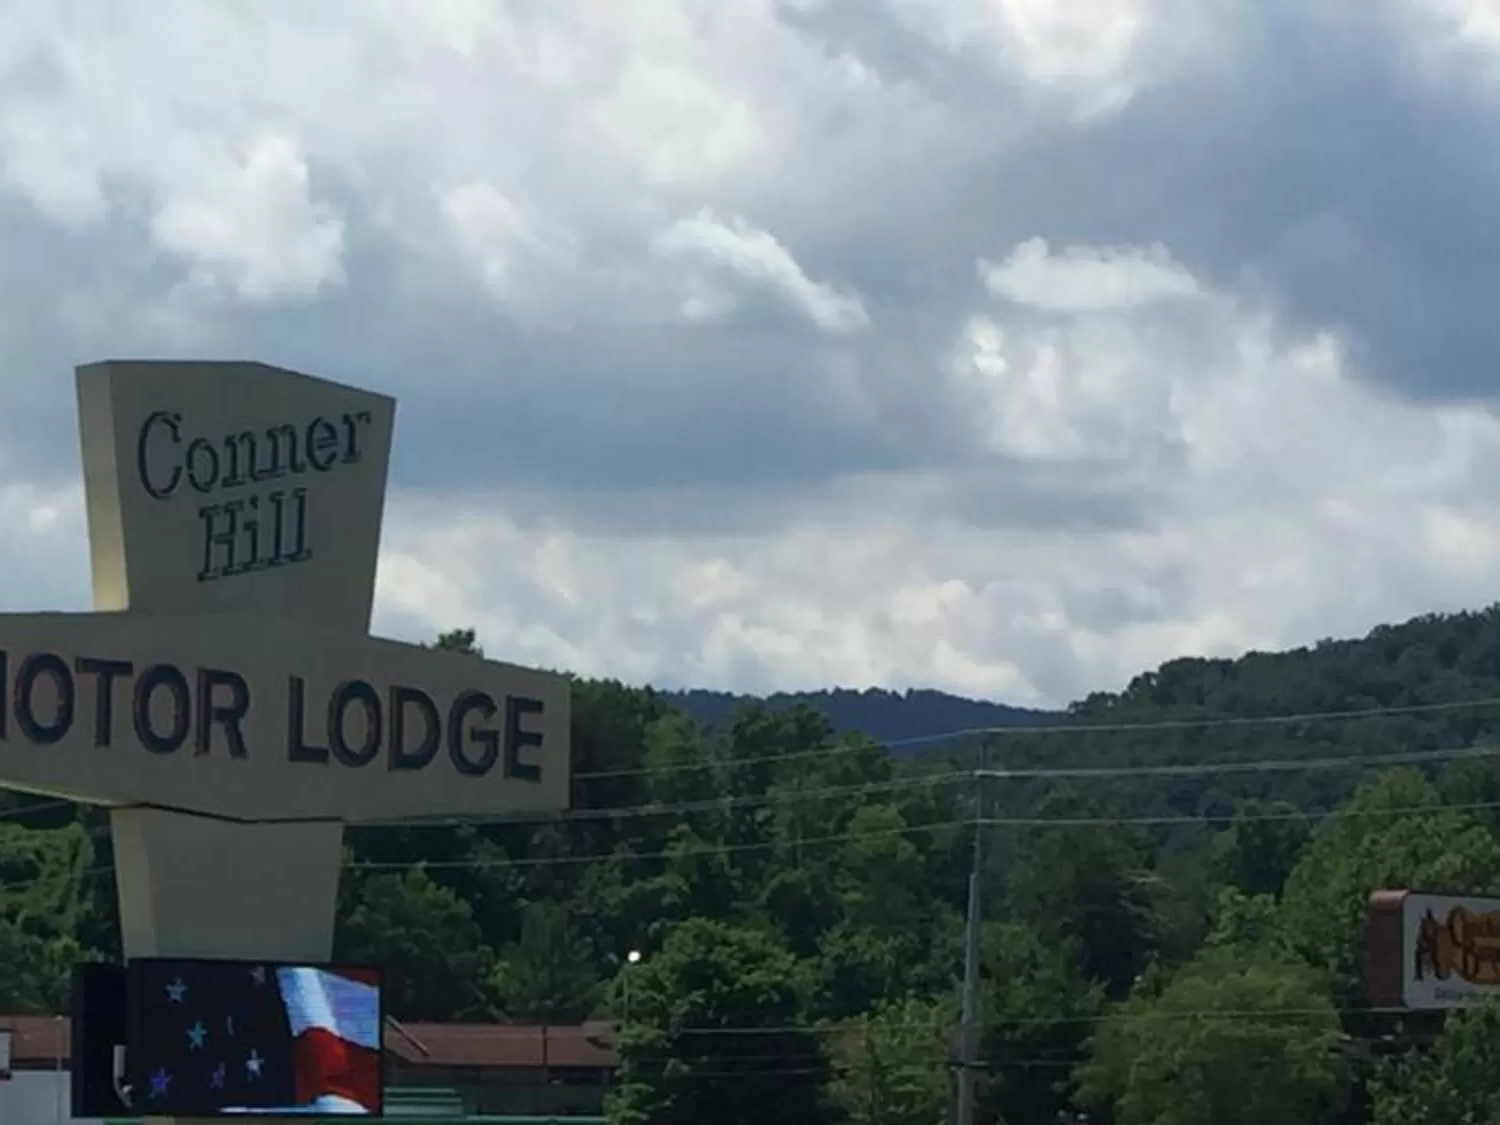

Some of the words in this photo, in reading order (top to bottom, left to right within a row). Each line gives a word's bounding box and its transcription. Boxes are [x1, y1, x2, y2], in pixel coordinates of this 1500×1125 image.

[137, 410, 372, 500] Conner
[196, 487, 313, 582] Hill
[286, 673, 545, 784] LODGE
